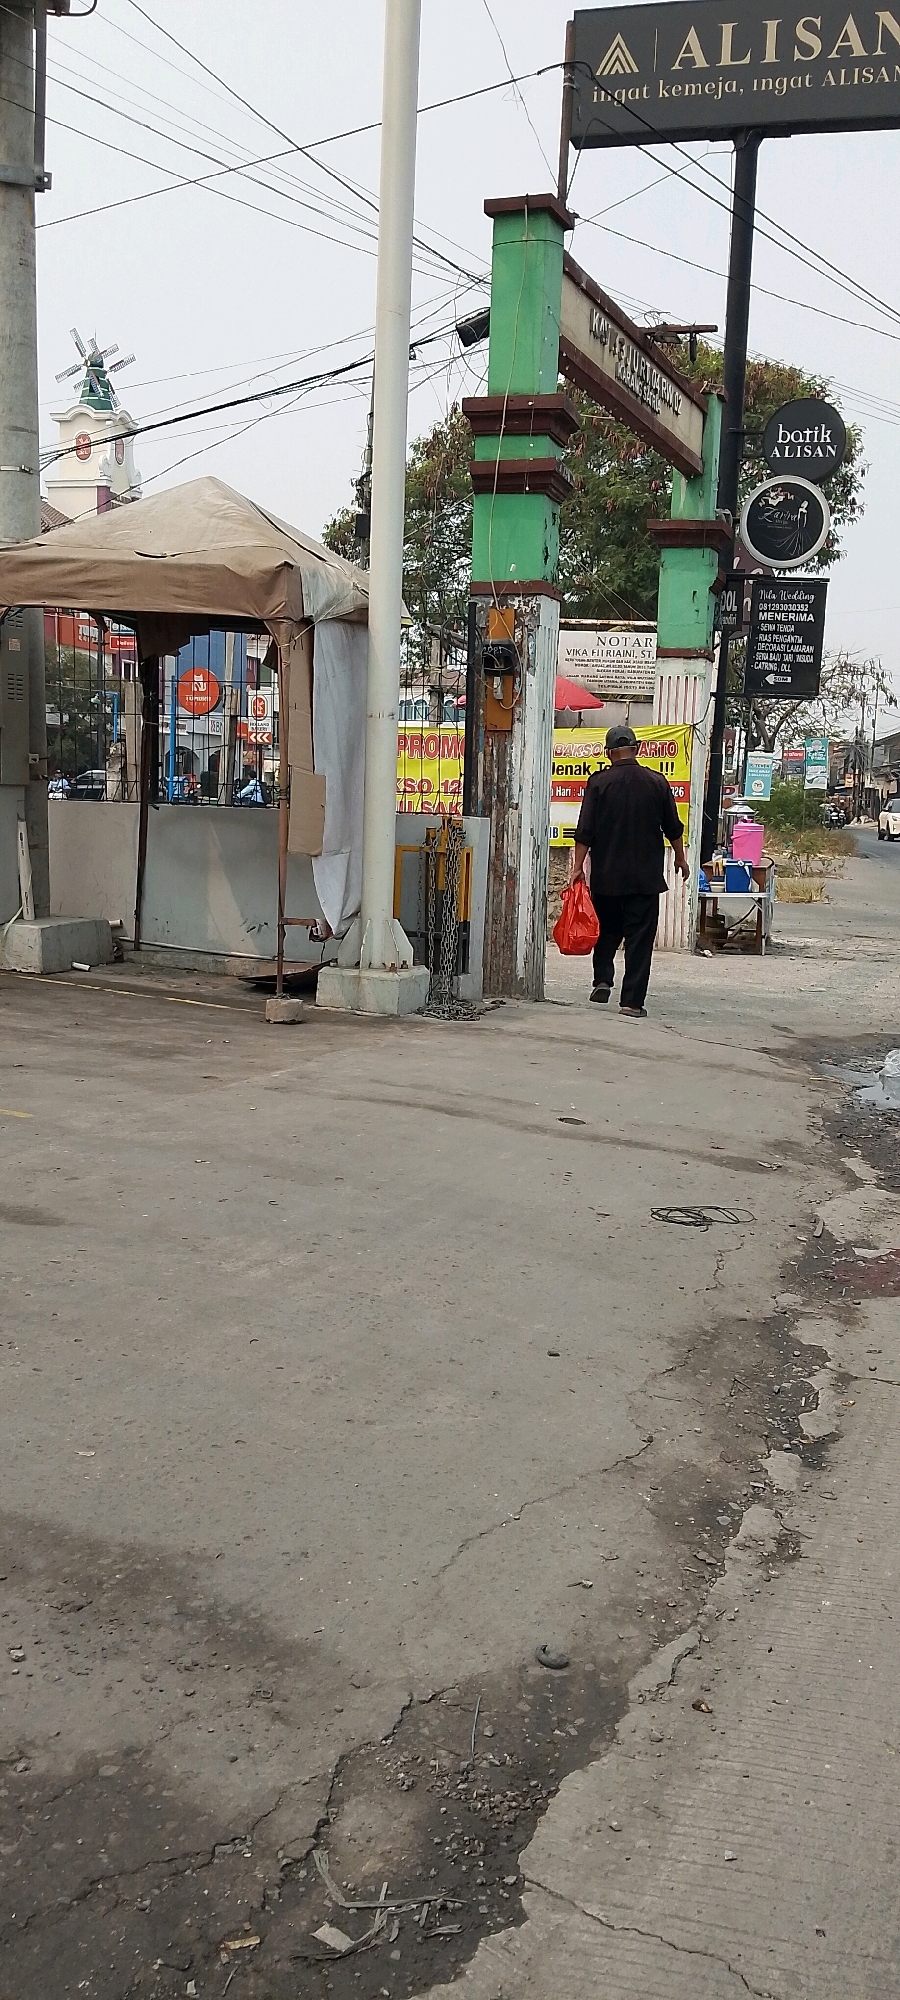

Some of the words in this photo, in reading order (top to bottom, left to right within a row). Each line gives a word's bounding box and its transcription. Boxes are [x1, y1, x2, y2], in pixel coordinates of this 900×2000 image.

[592, 82, 650, 106] ingat
[658, 77, 744, 101] kemeja,
[777, 424, 833, 444] batik
[770, 445, 838, 459] ALISAN
[758, 589, 777, 599] Nila
[780, 590, 816, 603] Wedding
[759, 603, 809, 612] 081293030352
[758, 612, 815, 622] MENERIMA
[597, 636, 654, 648] NOTAR
[566, 648, 588, 657] VIKA
[554, 741, 604, 758] BAKSO
[556, 786, 571, 797] Hari
